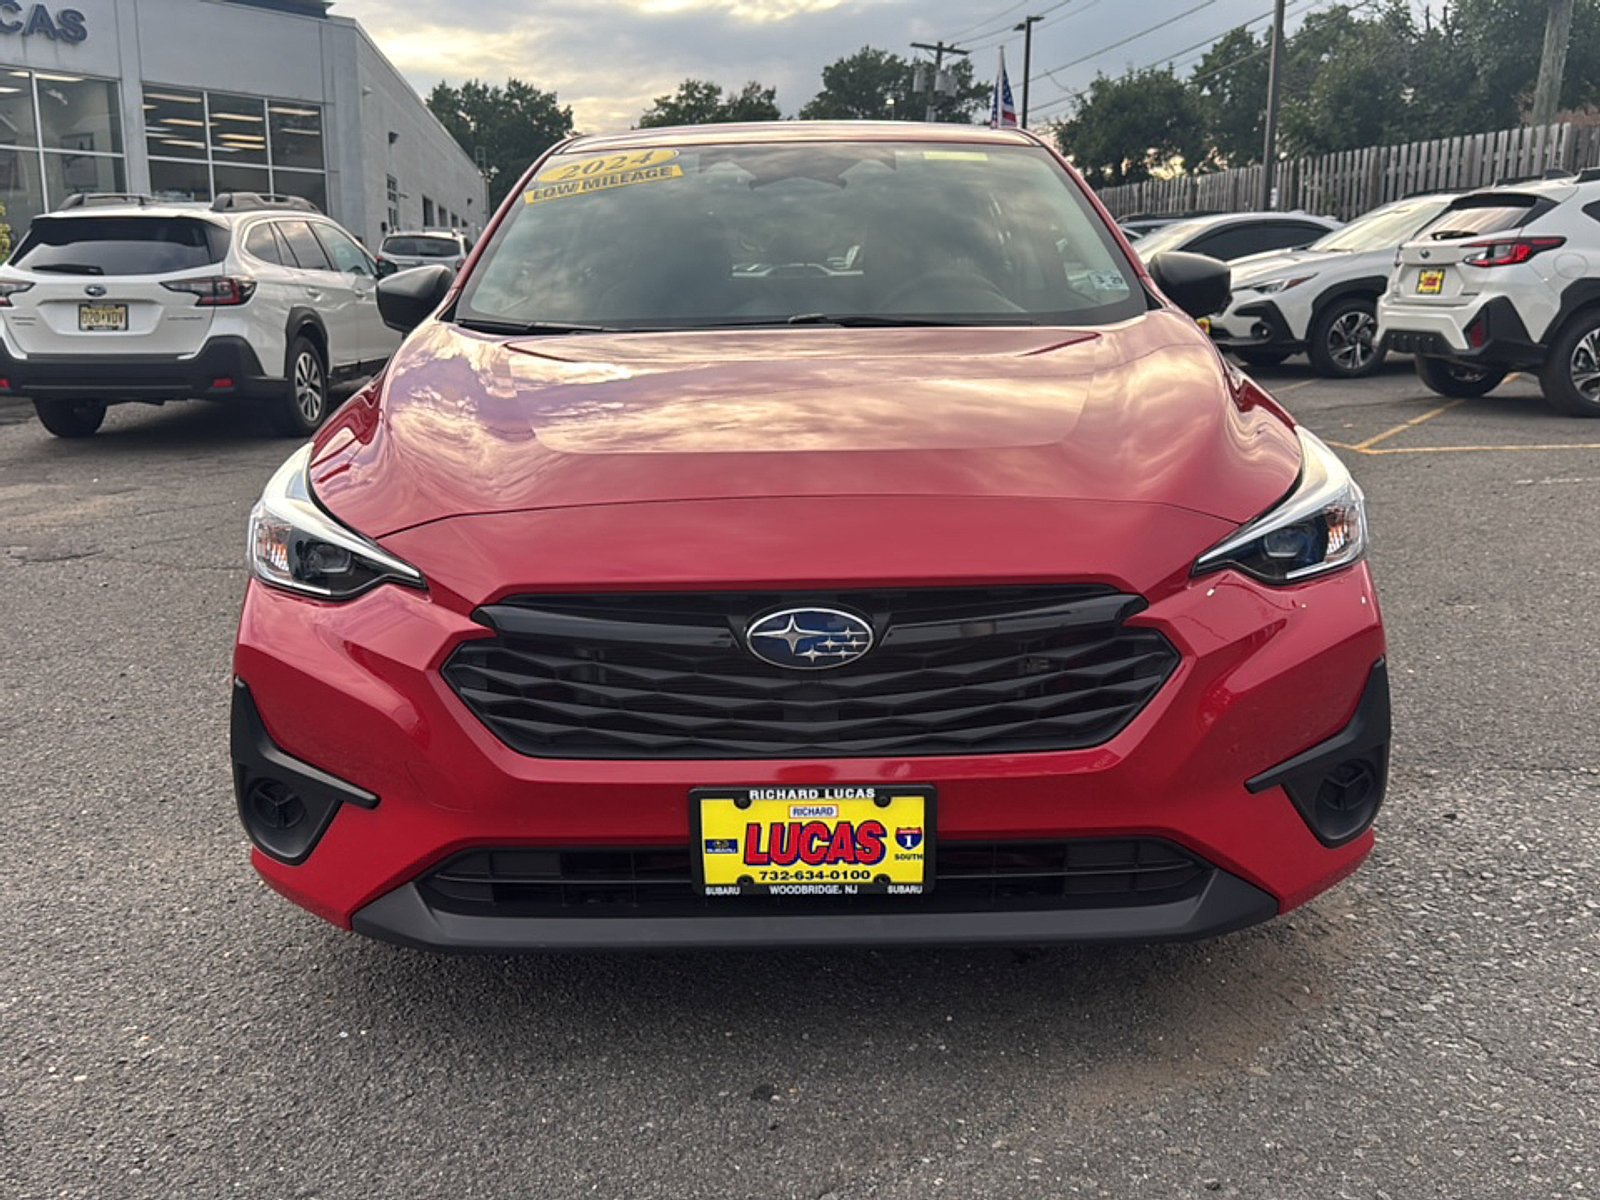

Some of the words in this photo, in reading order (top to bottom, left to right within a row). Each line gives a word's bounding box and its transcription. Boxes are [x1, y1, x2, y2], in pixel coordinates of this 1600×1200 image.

[560, 151, 654, 180] 2024
[533, 184, 579, 200] LOW
[581, 167, 672, 190] MILEAGE
[749, 789, 819, 800] RICHARD
[824, 788, 876, 799] LUCAS
[792, 807, 834, 817] RICHARD
[744, 820, 887, 865] LUCAS
[904, 834, 913, 848] 1
[894, 853, 924, 861] SOUTH
[759, 870, 871, 881] 732-634-0100
[705, 886, 741, 896] SUBARU
[844, 884, 859, 895] NJ
[887, 885, 923, 895] SUBARU
